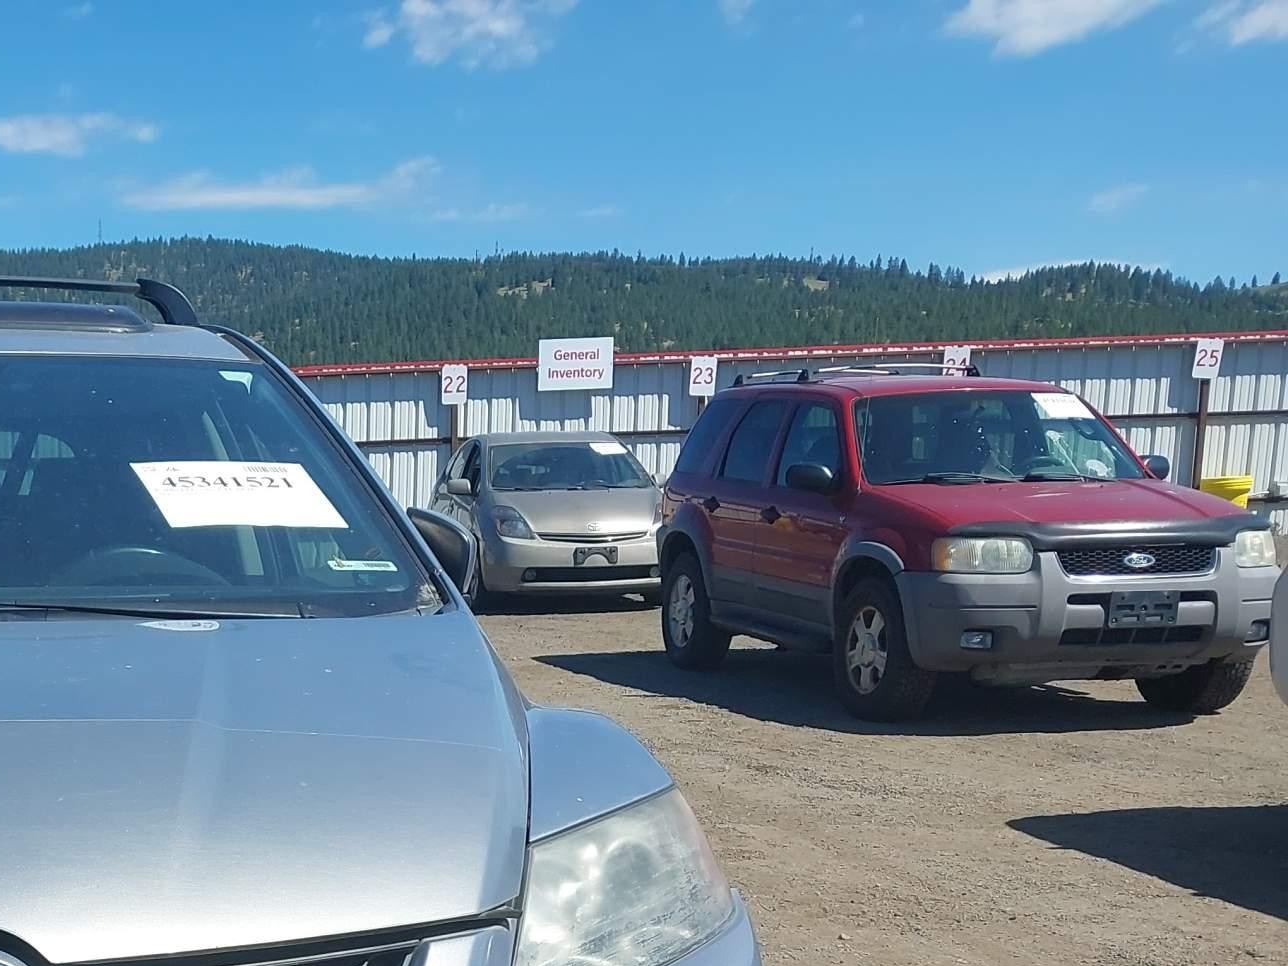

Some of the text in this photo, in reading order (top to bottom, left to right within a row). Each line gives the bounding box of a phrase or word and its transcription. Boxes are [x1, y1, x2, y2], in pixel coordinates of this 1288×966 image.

[553, 349, 600, 361] General
[1196, 348, 1220, 368] 25
[547, 367, 604, 380] Inventory
[692, 367, 714, 385] 23
[443, 375, 466, 394] 22
[162, 476, 294, 488] 45341521
